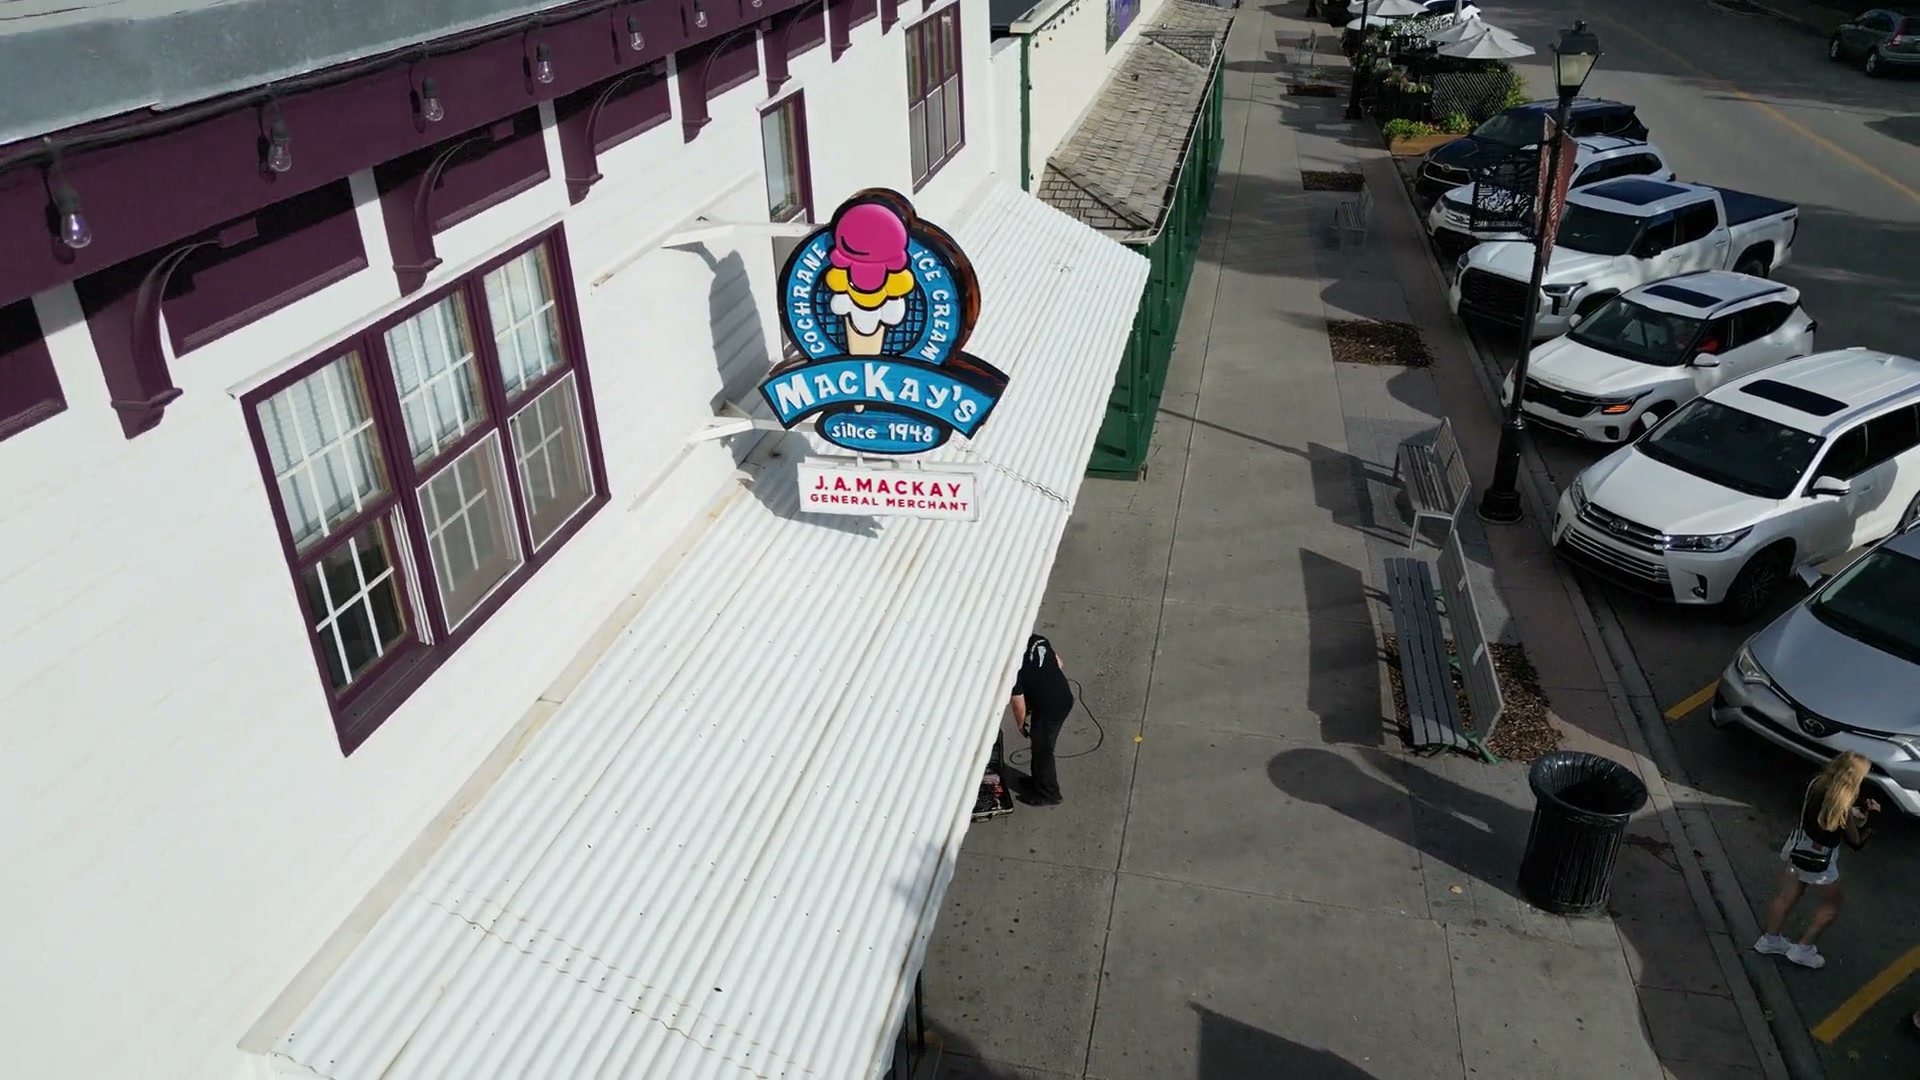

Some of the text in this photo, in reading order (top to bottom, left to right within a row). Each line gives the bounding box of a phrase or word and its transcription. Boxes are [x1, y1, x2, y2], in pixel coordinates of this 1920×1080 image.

[791, 242, 827, 355] COCHRANE
[912, 250, 950, 362] ICE CREAM
[831, 422, 934, 443] since 1948
[809, 493, 969, 512] GENERAL MERCHANT
